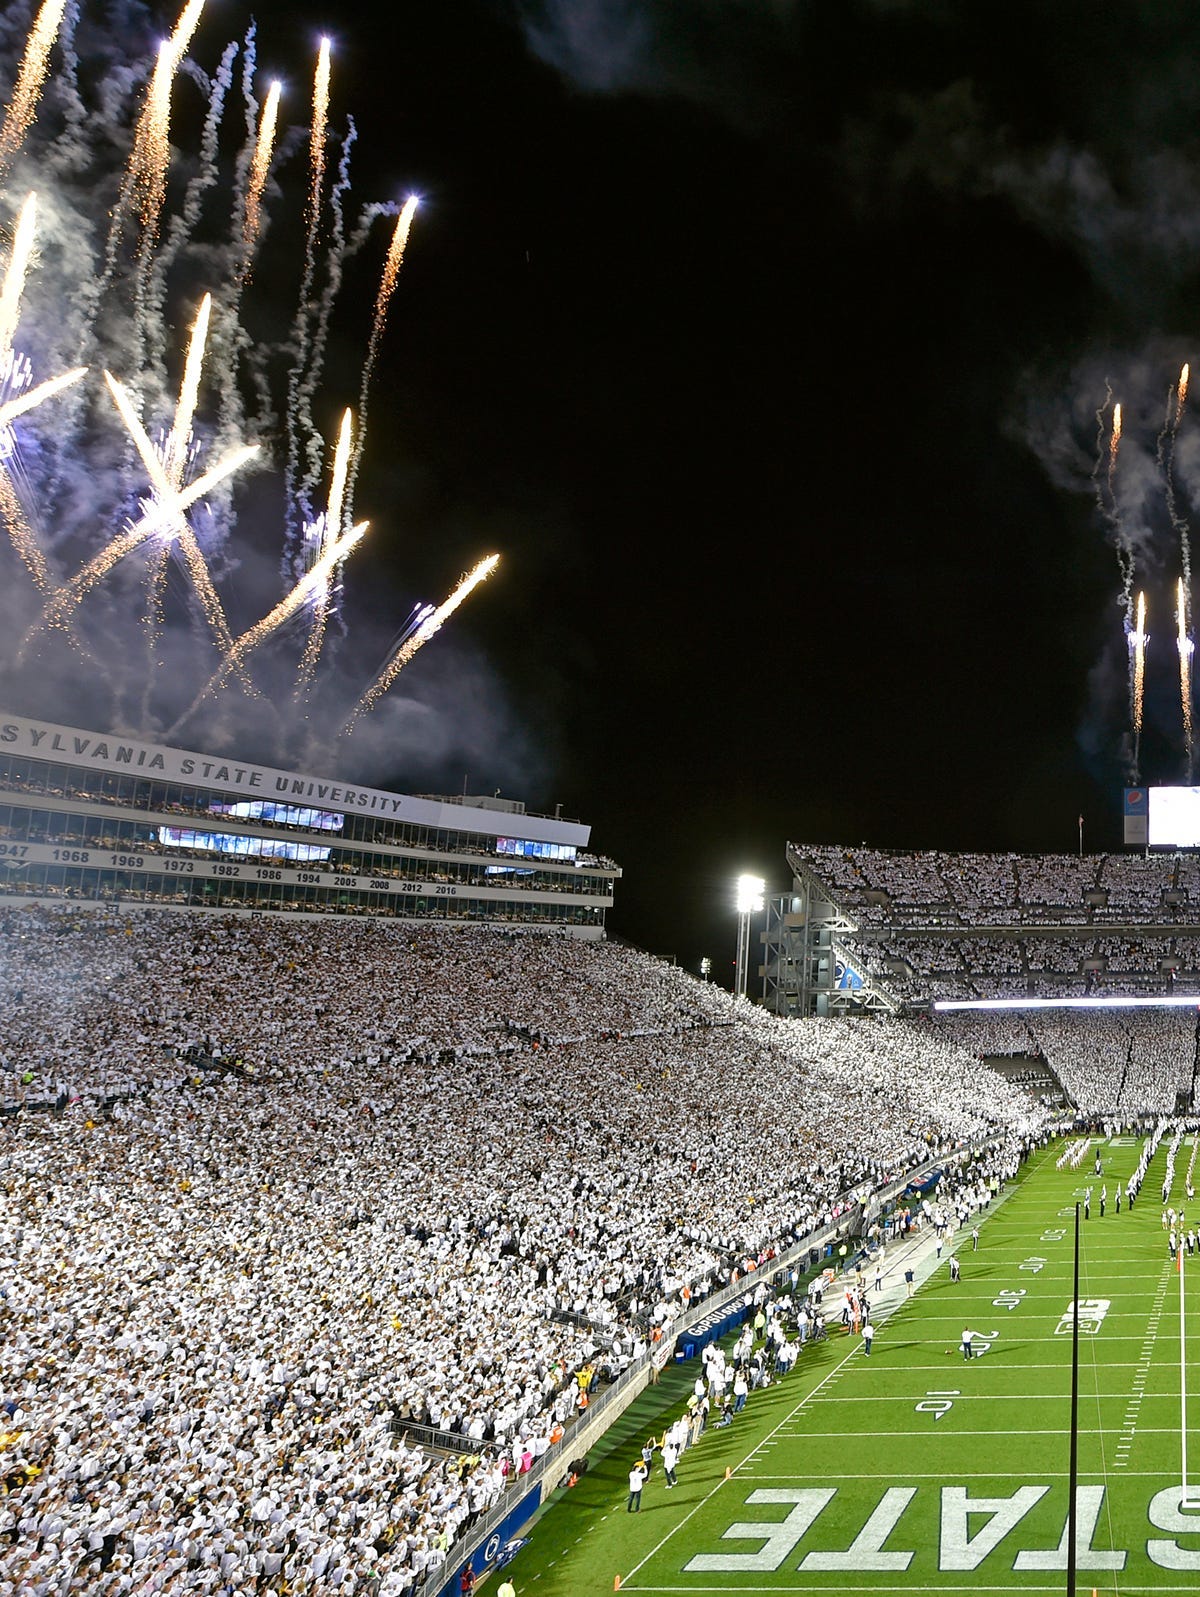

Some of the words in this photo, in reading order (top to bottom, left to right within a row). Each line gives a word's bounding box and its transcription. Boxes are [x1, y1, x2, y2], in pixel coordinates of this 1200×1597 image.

[0, 724, 165, 769] SYLVANIA
[181, 759, 263, 787] STATE
[275, 777, 402, 812] UNIVERSITY
[53, 849, 90, 863] 1968
[111, 855, 144, 868] 1969
[163, 860, 194, 873] 1973
[211, 865, 240, 877] 1982
[255, 869, 282, 881] 1986
[296, 873, 321, 884] 1994
[334, 877, 357, 887] 2005
[369, 880, 390, 890] 2008
[401, 883, 423, 893] 2012
[435, 886, 457, 895] 2016
[1039, 1228, 1067, 1241] 50
[1018, 1257, 1048, 1270] 40
[992, 1289, 1027, 1306] 30
[914, 1390, 961, 1412] 10
